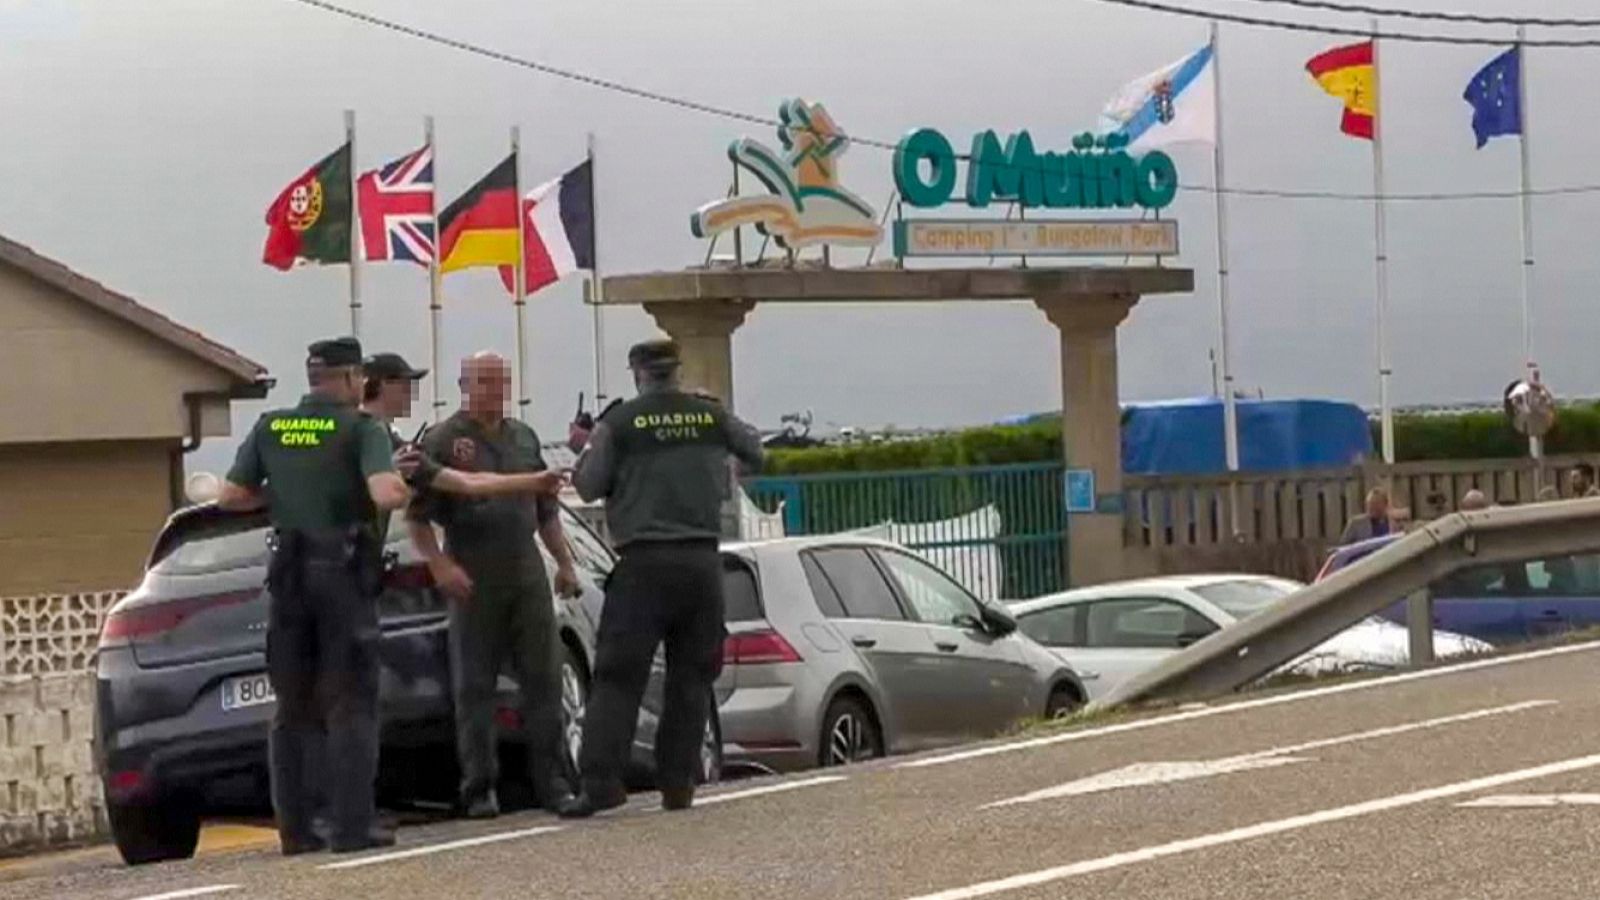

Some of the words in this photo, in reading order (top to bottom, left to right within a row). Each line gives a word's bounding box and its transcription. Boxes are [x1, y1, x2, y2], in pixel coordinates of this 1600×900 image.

[893, 128, 956, 208] O
[914, 225, 994, 251] Camping
[1132, 225, 1172, 248] Park
[271, 418, 335, 431] GUARDIA
[634, 411, 714, 429] GUARDIA
[281, 432, 320, 445] CIVIL
[655, 426, 699, 441] CIVIL
